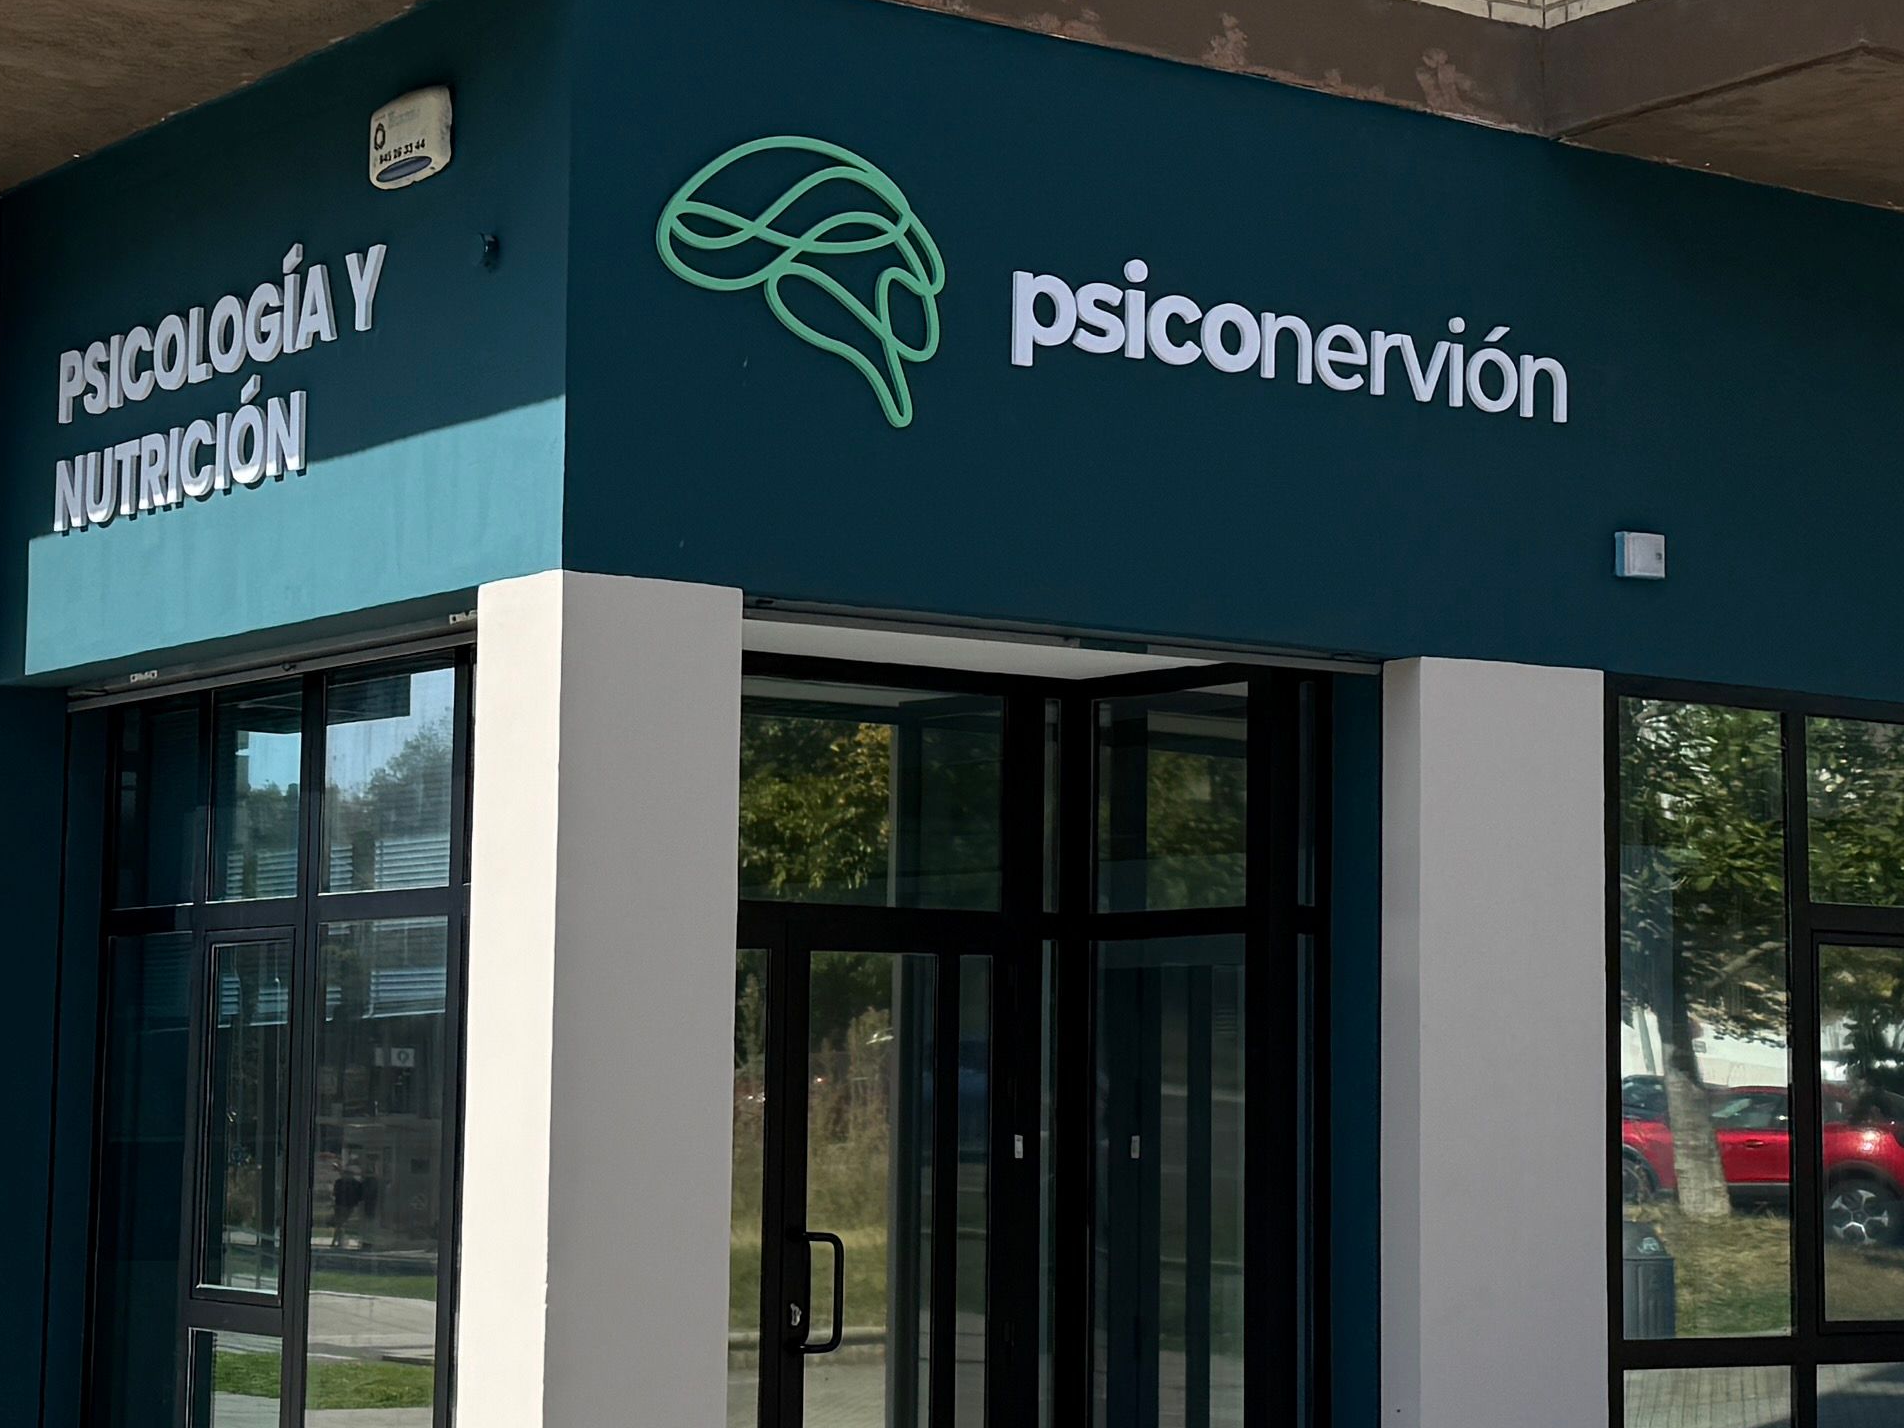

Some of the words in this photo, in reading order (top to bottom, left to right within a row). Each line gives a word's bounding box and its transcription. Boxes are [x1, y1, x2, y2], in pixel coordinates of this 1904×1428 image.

[58, 243, 338, 424] PSICOLOGÍA
[345, 243, 388, 332] Y
[1011, 258, 1568, 423] psiconervión
[53, 375, 307, 532] NUTRICIÓN
